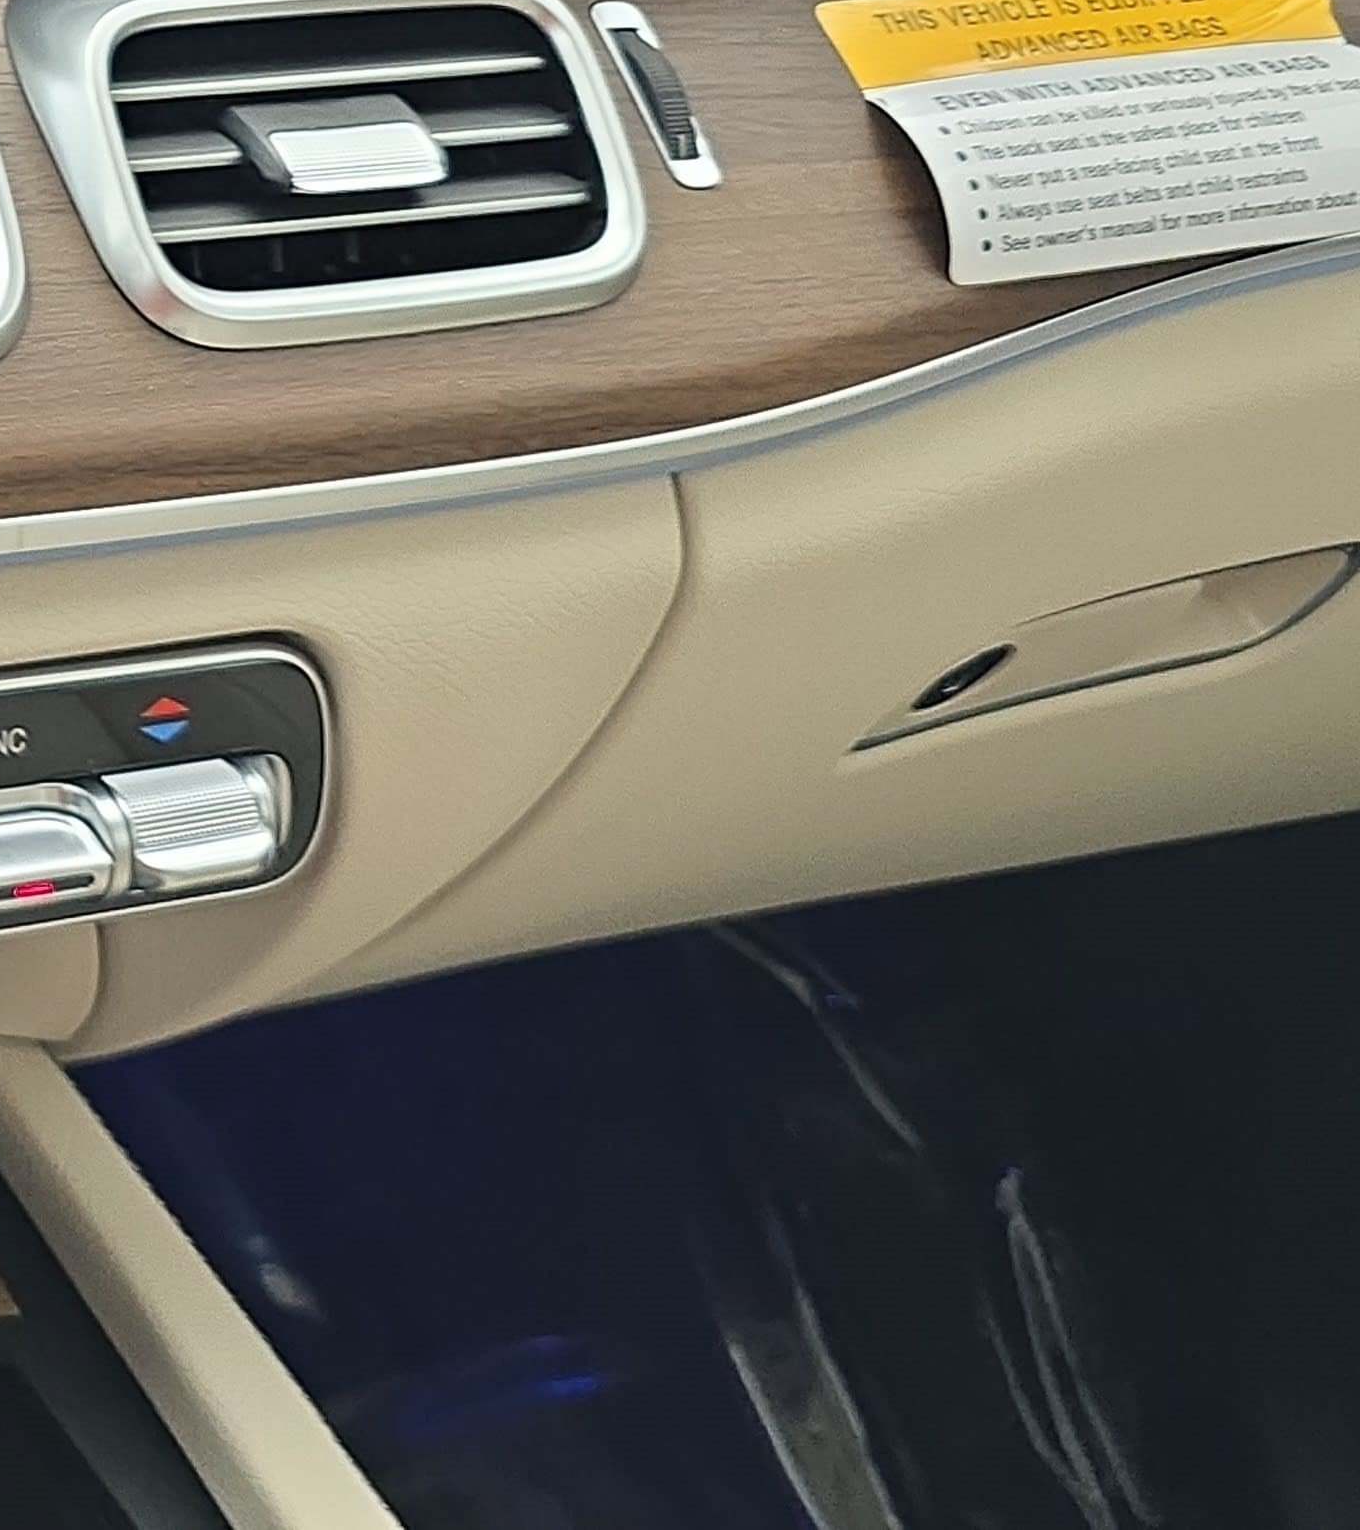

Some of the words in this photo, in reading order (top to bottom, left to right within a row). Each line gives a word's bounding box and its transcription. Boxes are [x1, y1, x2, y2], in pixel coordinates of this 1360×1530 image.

[872, 8, 940, 34] THIS
[976, 29, 1110, 61] ADVANCED
[1116, 24, 1160, 46] AIR
[1160, 16, 1227, 42] BAGS
[933, 90, 1008, 112] EVEN
[1007, 80, 1080, 102] WITH
[1082, 67, 1215, 94] ADVANCED
[1218, 63, 1266, 80] AIR
[1261, 55, 1331, 74] BAGS
[970, 144, 1006, 160] The
[985, 171, 1034, 190] Never
[997, 202, 1054, 222] Always
[1001, 233, 1032, 253] See
[1034, 225, 1098, 250] owner's
[1097, 215, 1158, 239] manual
[1157, 211, 1182, 231] for
[1183, 208, 1226, 228] more
[1225, 196, 1316, 223] information
